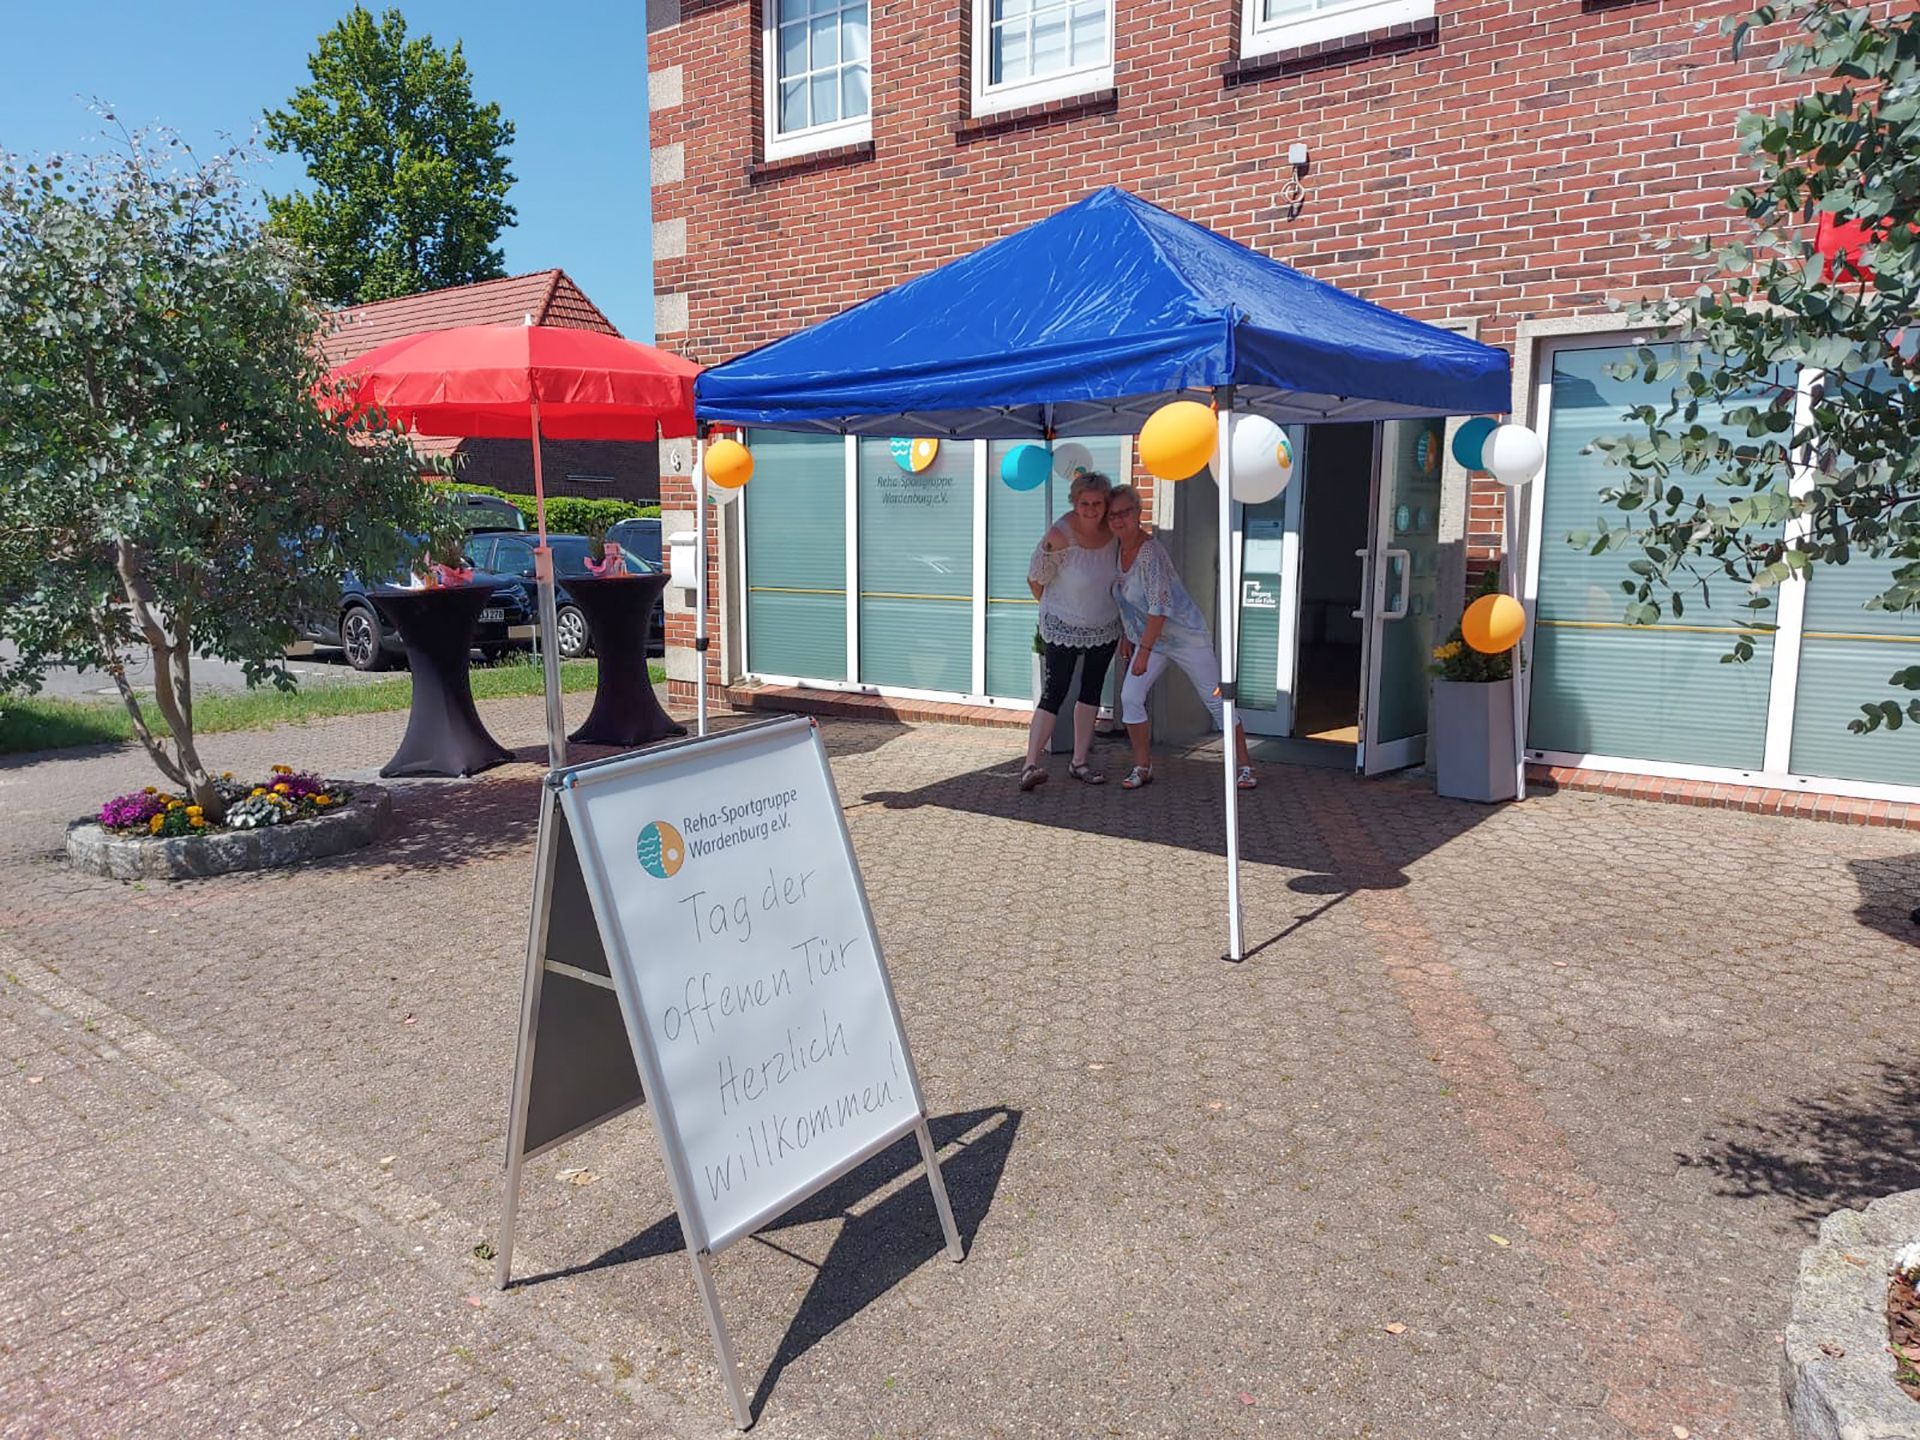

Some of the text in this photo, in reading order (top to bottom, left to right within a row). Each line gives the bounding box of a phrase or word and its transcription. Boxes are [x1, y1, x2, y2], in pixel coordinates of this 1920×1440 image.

[683, 788, 798, 836] Reha-Sportgruppe
[688, 811, 791, 860] Wardenburg e.V.
[679, 867, 816, 943] Tag der
[664, 936, 858, 1046] offenen Tür
[718, 1008, 848, 1116] Herzlich
